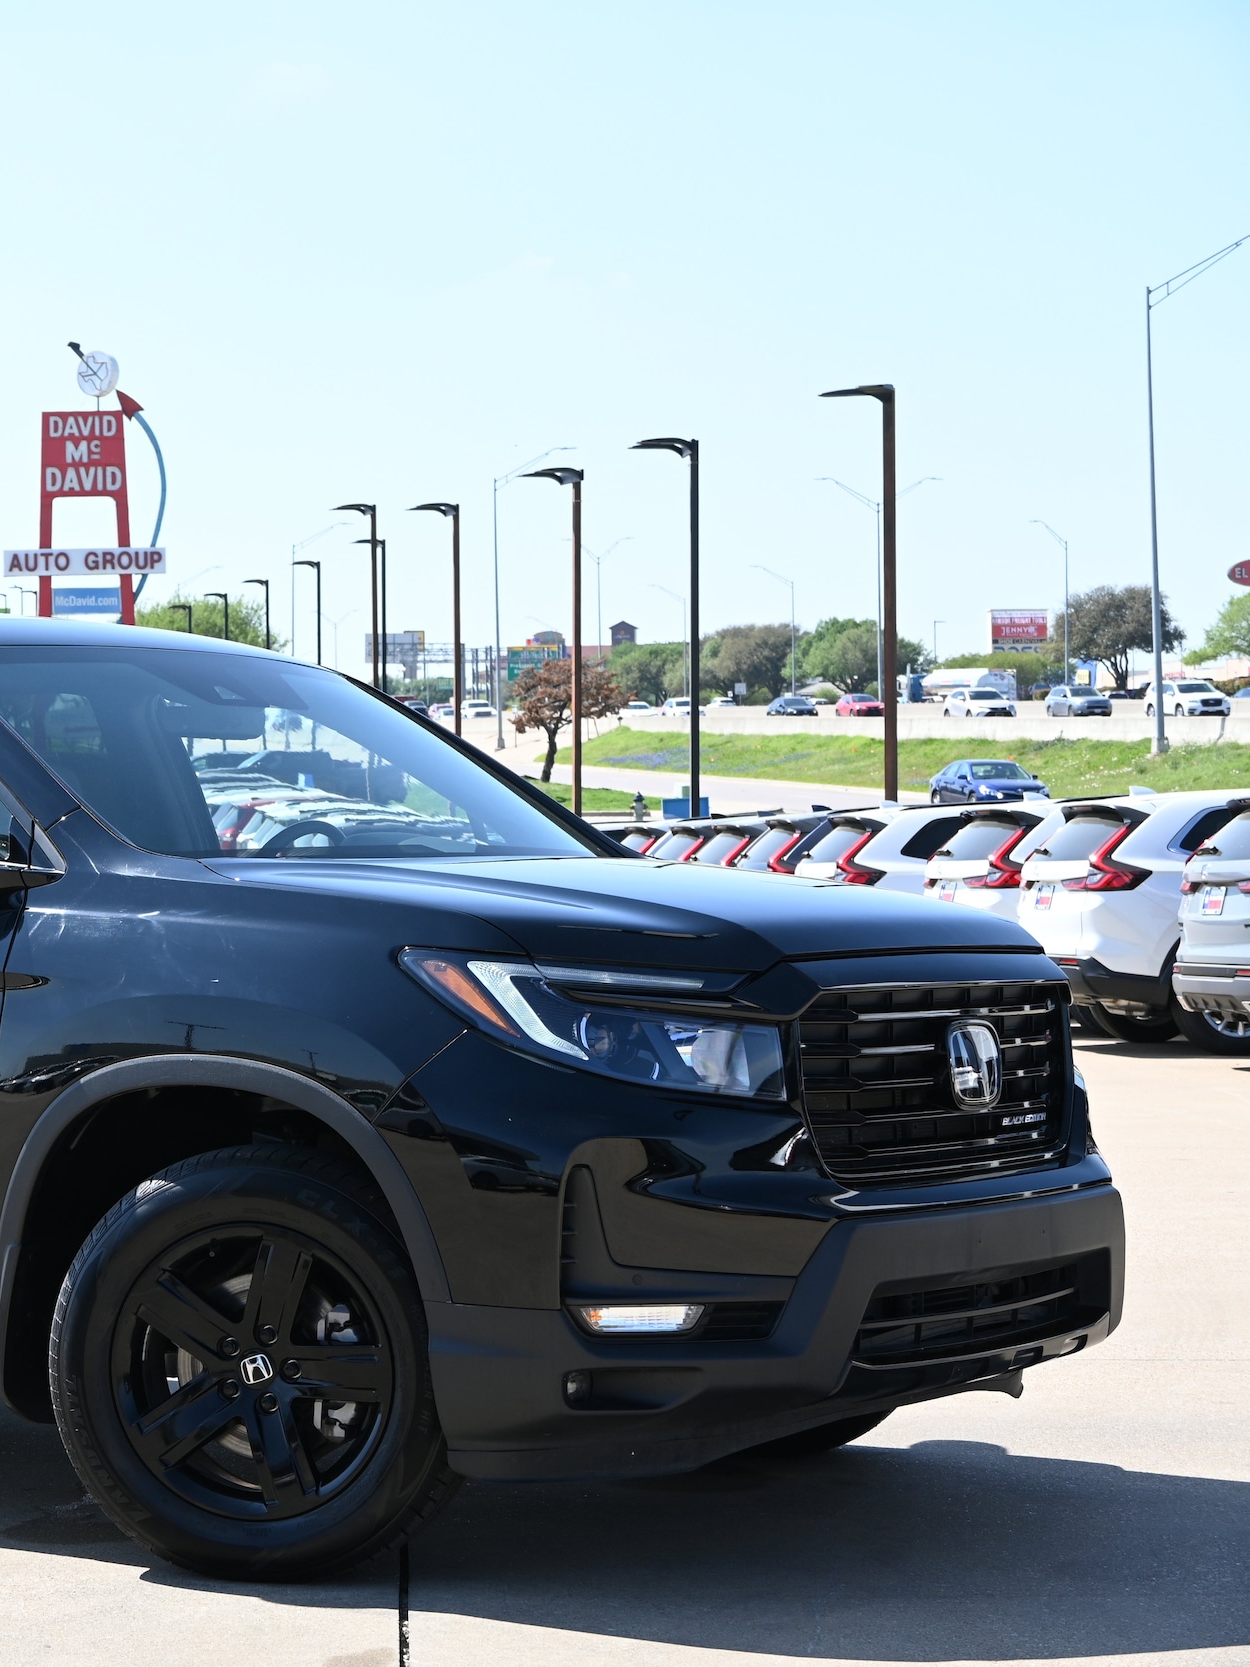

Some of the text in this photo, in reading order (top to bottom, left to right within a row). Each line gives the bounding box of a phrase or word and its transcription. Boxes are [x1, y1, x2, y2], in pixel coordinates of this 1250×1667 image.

[49, 415, 117, 438] DAVID
[45, 466, 122, 492] DAVID
[9, 551, 163, 572] AUTO GROUP
[1234, 567, 1249, 579] EL
[55, 596, 118, 607] McDavid.com
[1002, 1115, 1025, 1126] BLACK
